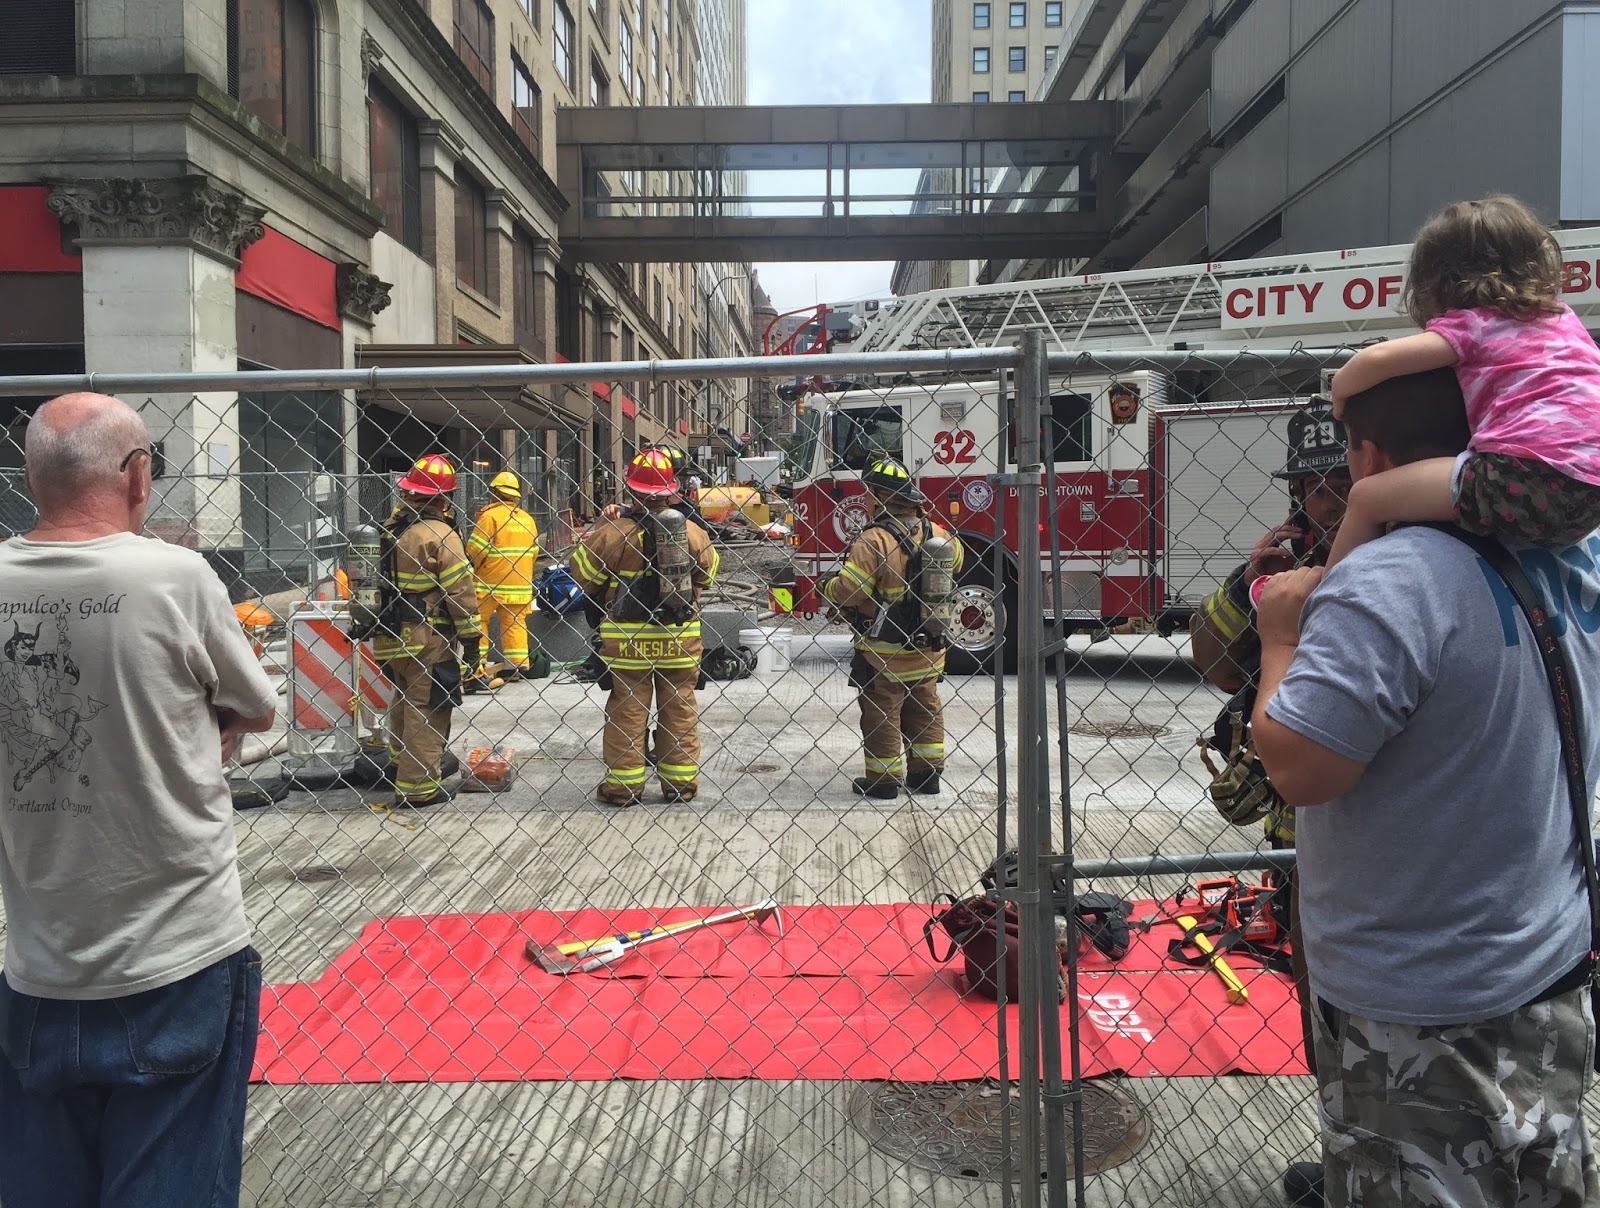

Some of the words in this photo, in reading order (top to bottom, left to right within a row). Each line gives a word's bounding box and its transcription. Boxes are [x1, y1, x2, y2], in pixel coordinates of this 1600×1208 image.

[1226, 281, 1324, 319] CITY
[1343, 275, 1403, 310] OF
[933, 430, 977, 464] 32
[1303, 421, 1335, 449] 29
[793, 502, 809, 520] 32
[0, 594, 72, 623] apulco's
[79, 594, 127, 619] Gold
[8, 798, 56, 813] Portland
